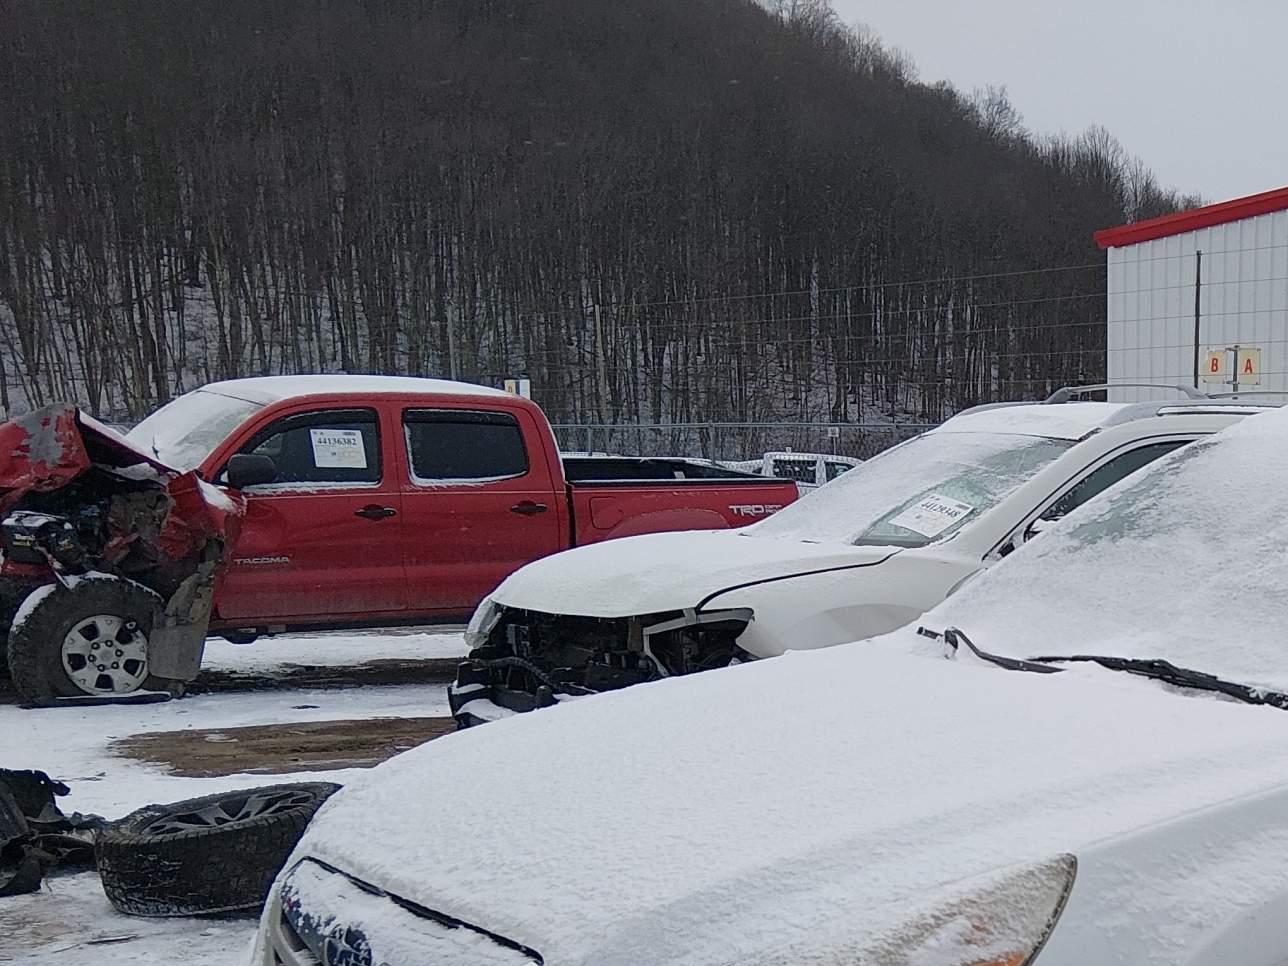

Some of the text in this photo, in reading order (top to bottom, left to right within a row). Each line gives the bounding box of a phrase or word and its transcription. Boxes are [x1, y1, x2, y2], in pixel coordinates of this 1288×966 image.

[1210, 357, 1219, 373] B
[1244, 358, 1253, 374] A
[728, 504, 764, 516] TRD
[233, 556, 289, 565] TACOMA
